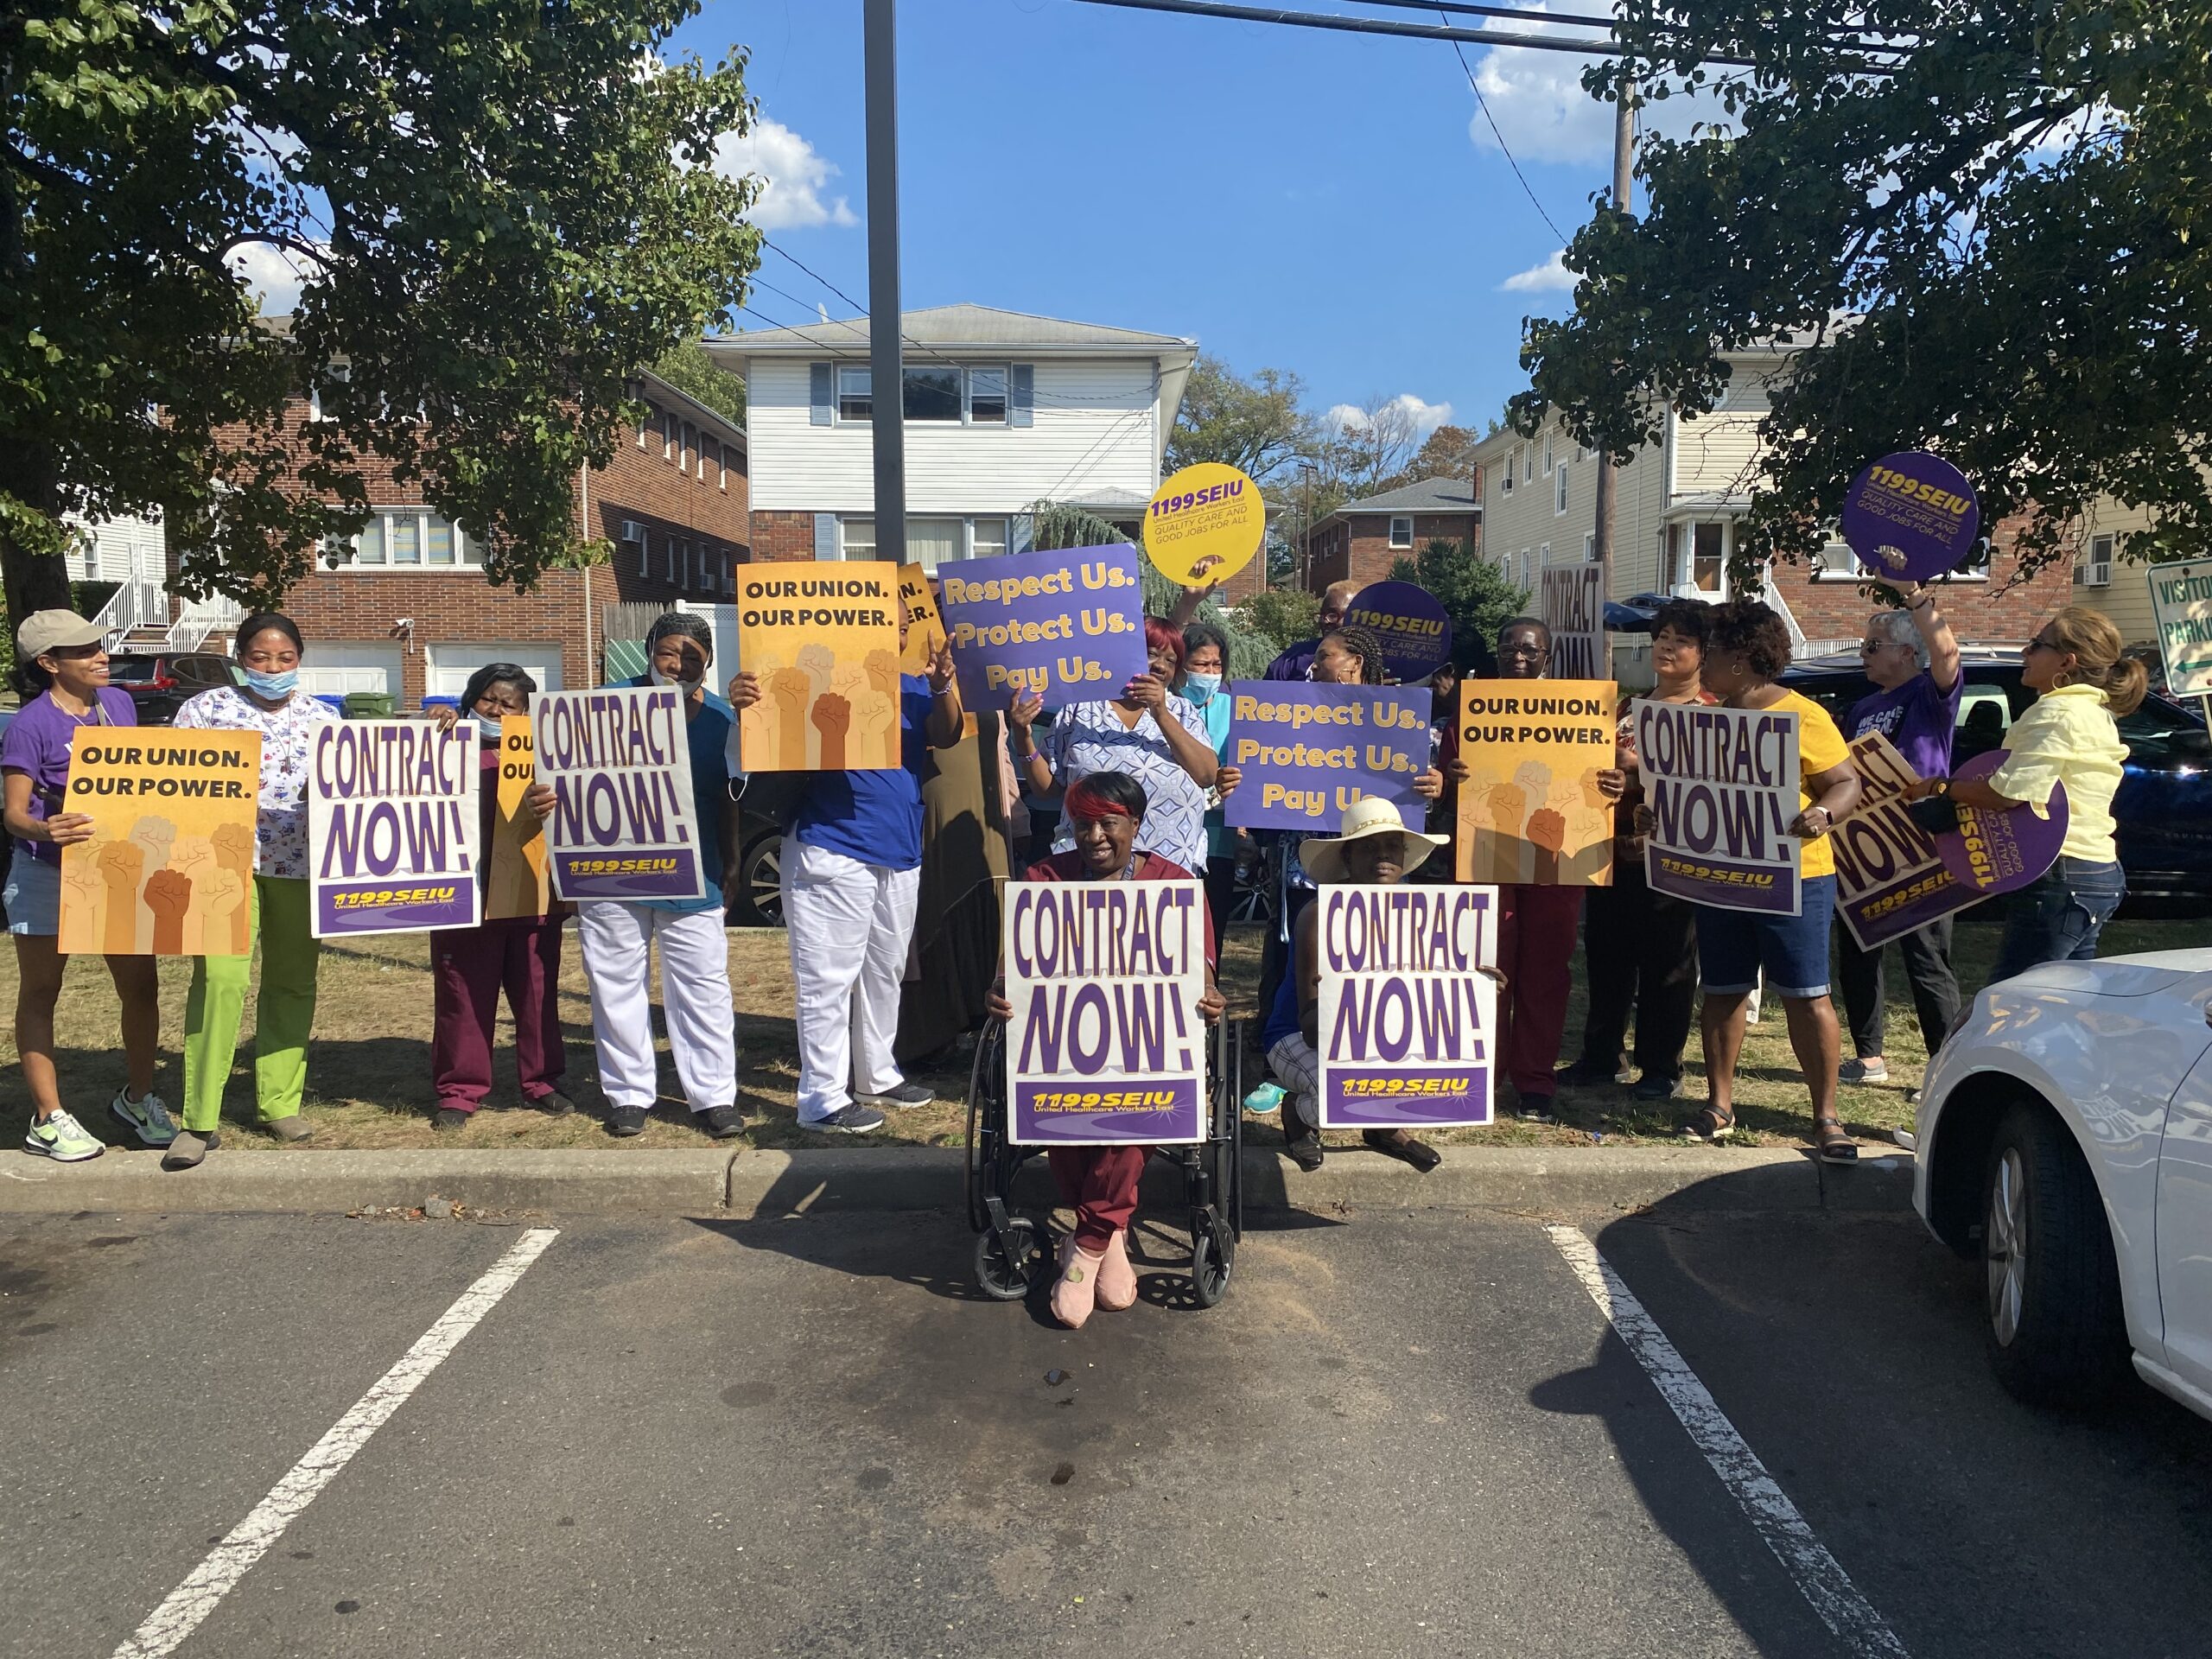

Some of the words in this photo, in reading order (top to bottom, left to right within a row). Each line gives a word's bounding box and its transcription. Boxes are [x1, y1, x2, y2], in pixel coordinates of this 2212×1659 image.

[1151, 479, 1243, 517] 1199SEIU
[1869, 466, 1971, 515] 1199SEIU
[1154, 518, 1197, 536] QUALITY
[1198, 512, 1225, 524] CARE
[1226, 505, 1248, 516] AND
[1857, 499, 1886, 517] GOOD
[1886, 512, 1913, 527] JOBS
[1912, 523, 1935, 535] FOR
[1934, 531, 1953, 544] ALL
[1861, 491, 1905, 512] QUALITY
[1905, 508, 1935, 525] CARE
[1933, 521, 1959, 535] AND
[1155, 531, 1183, 544] GOOD
[1185, 526, 1208, 537] JOBS
[1211, 520, 1230, 531] FOR
[1231, 516, 1249, 525] ALL
[746, 581, 798, 599] OUR
[801, 581, 888, 598] UNION.
[944, 568, 1074, 606] Respect
[1080, 562, 1135, 590] Us.
[2158, 575, 2212, 605] VISITO
[742, 609, 795, 627] OUR
[798, 608, 893, 626] POWER.
[954, 613, 1074, 649] Protect
[1080, 607, 1135, 636] Us.
[1351, 608, 1444, 636] 1199SEIU
[2164, 616, 2212, 646] PARKI
[1382, 647, 1400, 658] OBS
[1400, 650, 1421, 659] FOR
[1421, 653, 1439, 662] ALL
[1390, 640, 1417, 651] CARE
[1419, 645, 1441, 654] AND
[986, 664, 1049, 693] Pay
[1057, 656, 1112, 683] Us.
[1235, 695, 1364, 729] Respect
[1372, 702, 1427, 730] Us.
[1468, 698, 1519, 715] OUR
[1522, 698, 1608, 716] UNION.
[1858, 714, 1875, 728] WE
[507, 734, 533, 752] OU
[538, 692, 677, 771] CONTRACT
[1464, 726, 1515, 743] OUR
[1518, 726, 1611, 745] POWER.
[1640, 705, 1791, 787] CONTRACT
[81, 747, 142, 765] OUR
[147, 748, 250, 768] UNION.
[316, 725, 472, 799] CONTRACT
[503, 763, 536, 779] OU
[1236, 739, 1357, 769] Protect
[1365, 745, 1419, 773] Us.
[72, 777, 134, 795] OUR
[138, 779, 251, 798] POWER.
[1262, 783, 1325, 817] Pay
[553, 771, 690, 847] NOW!
[1649, 779, 1791, 861] NOW!
[319, 801, 471, 879] NOW!
[1999, 812, 2014, 839] JOBS
[1831, 798, 1939, 901] NOW
[1955, 802, 1995, 888] 1199SE
[1992, 830, 2014, 877] QUALITY
[2008, 841, 2024, 873] GOOD
[569, 858, 677, 872] 1199SEIU
[1660, 858, 1774, 885] 1199SEIU
[333, 887, 455, 906] 1199SEIU
[1014, 887, 1195, 979] CONTRACT
[1326, 890, 1491, 973] CONTRACT
[1016, 982, 1194, 1076] NOW!
[1327, 976, 1486, 1063] NOW!
[1033, 1090, 1176, 1107] 1199SEIU
[1341, 1077, 1469, 1092] 1199SEIU
[1065, 1104, 1114, 1113] Healthcare
[1116, 1104, 1154, 1113] Workers
[1155, 1103, 1175, 1112] East
